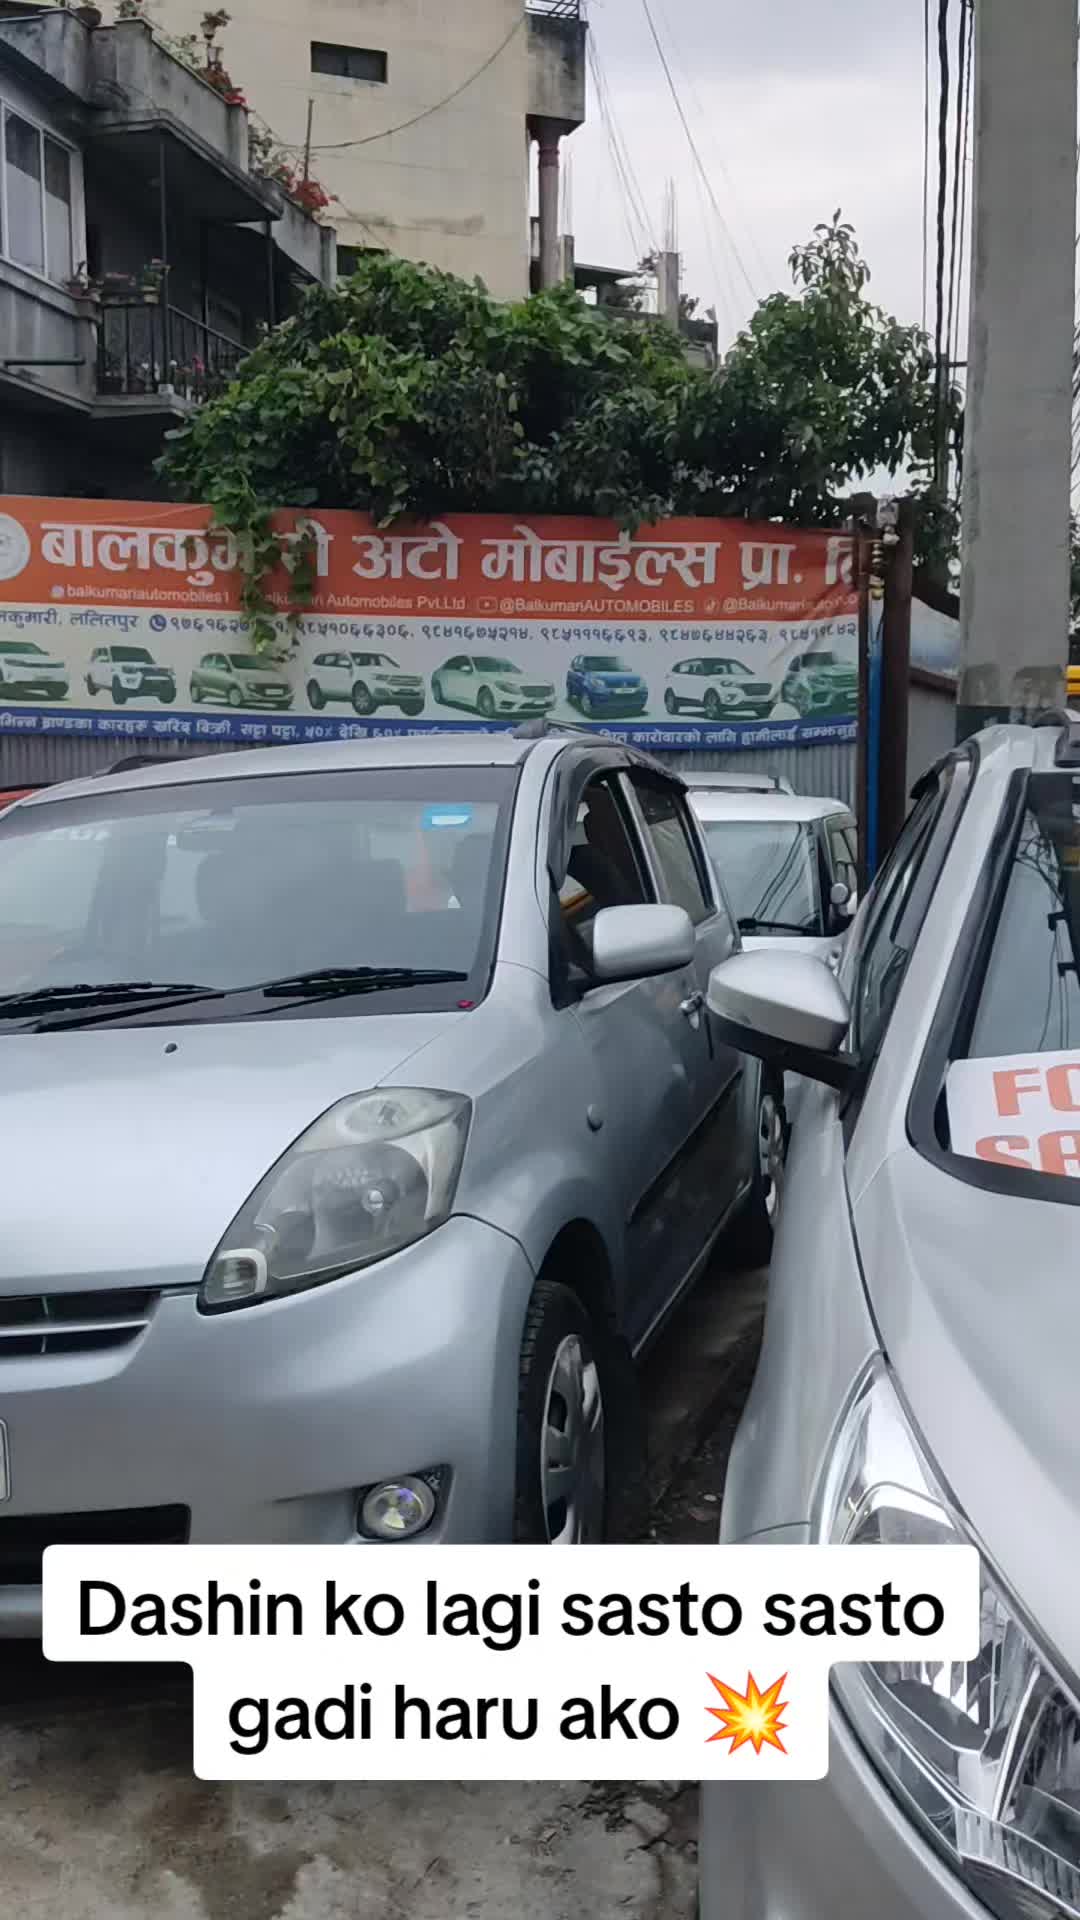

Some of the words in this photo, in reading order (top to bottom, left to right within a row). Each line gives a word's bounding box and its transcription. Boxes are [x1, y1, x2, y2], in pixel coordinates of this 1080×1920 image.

[352, 521, 464, 581] अटो
[738, 542, 804, 592] प्रा.
[327, 594, 413, 609] Automobiles
[70, 609, 139, 632] ललितपुर
